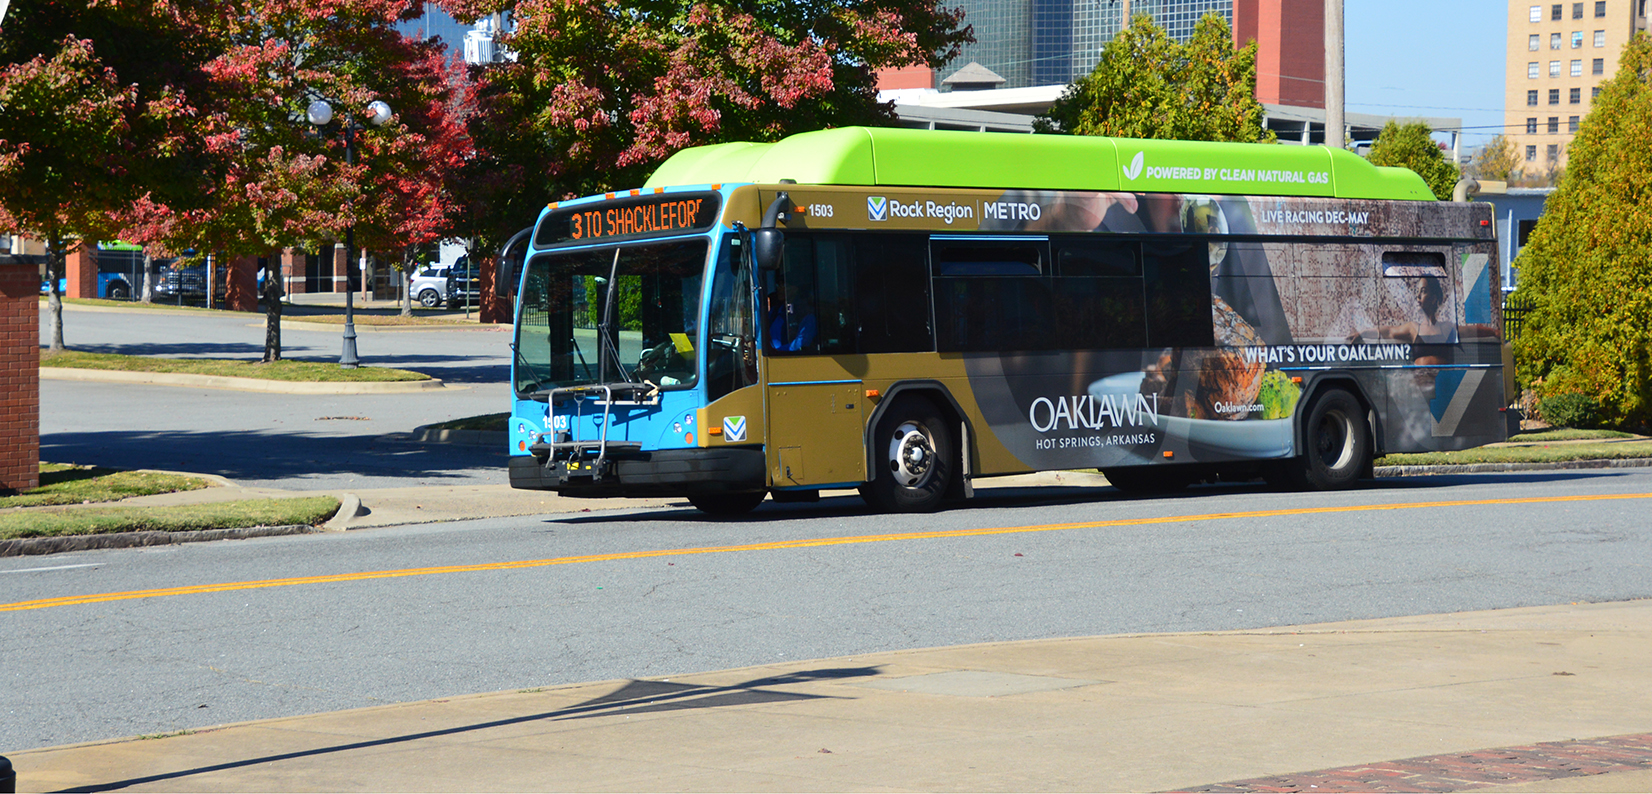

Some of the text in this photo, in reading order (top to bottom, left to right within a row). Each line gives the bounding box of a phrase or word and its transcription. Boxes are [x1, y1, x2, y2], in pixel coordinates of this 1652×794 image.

[1146, 166, 1329, 184] POWERED BY CLEAN NATURAL GAS
[808, 204, 834, 218] 1503
[889, 200, 1041, 224] Rock Region METRO
[1262, 210, 1369, 224] LIVE RACING DEC-MAY
[571, 213, 582, 239] 3
[584, 211, 602, 238] TO
[1245, 343, 1411, 363] WHAT'S YOUR OAKLAWN?
[1029, 392, 1158, 433] OAKLAWN
[1214, 401, 1265, 413] Oaklawn.com
[1036, 433, 1156, 450] HOT SPRINGS, ARKANSAS
